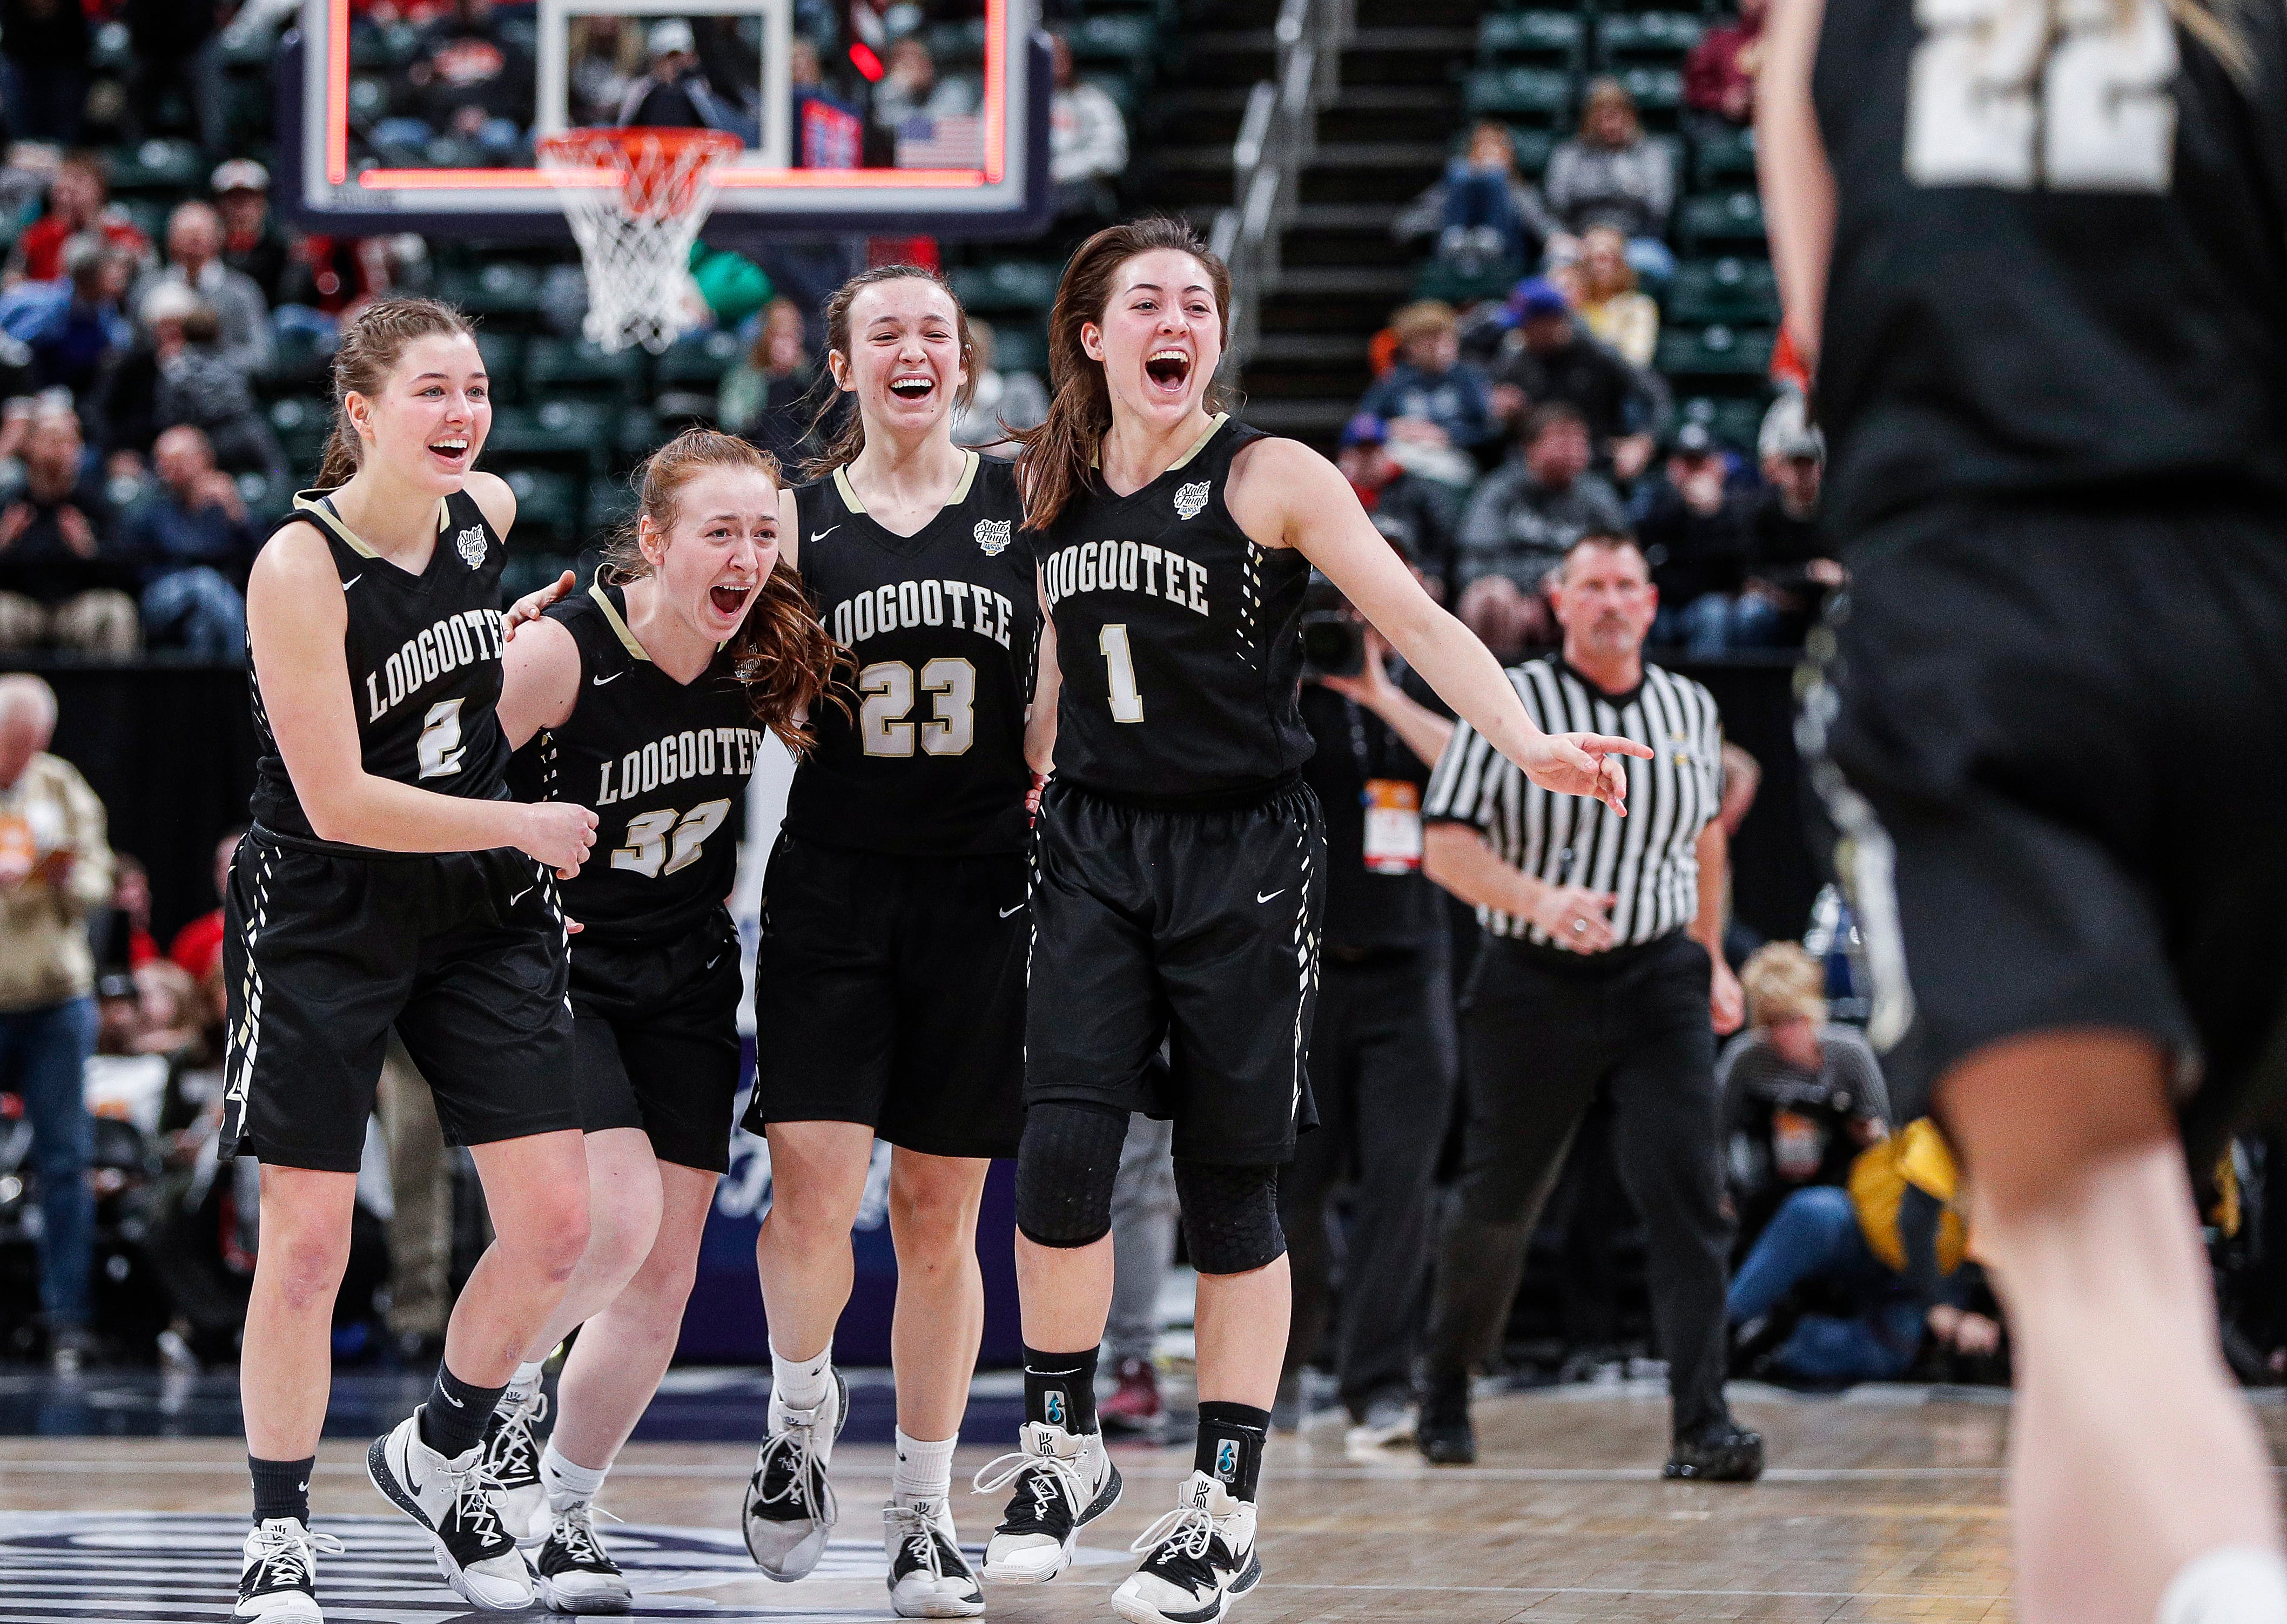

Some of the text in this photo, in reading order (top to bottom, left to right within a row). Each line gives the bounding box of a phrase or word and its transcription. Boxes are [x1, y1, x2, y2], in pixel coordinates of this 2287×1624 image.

[1905, 0, 2180, 193] 22
[1176, 493, 1207, 507] Finals
[1178, 482, 1209, 496] State
[459, 525, 482, 545] State
[460, 537, 486, 557] Finals
[976, 531, 1009, 544] Finals
[977, 521, 1010, 532] State
[366, 609, 503, 724] LOOGOOTE
[1099, 624, 1144, 723] 1
[859, 657, 976, 757] 23
[416, 697, 466, 780] 2
[610, 798, 731, 878] 32
